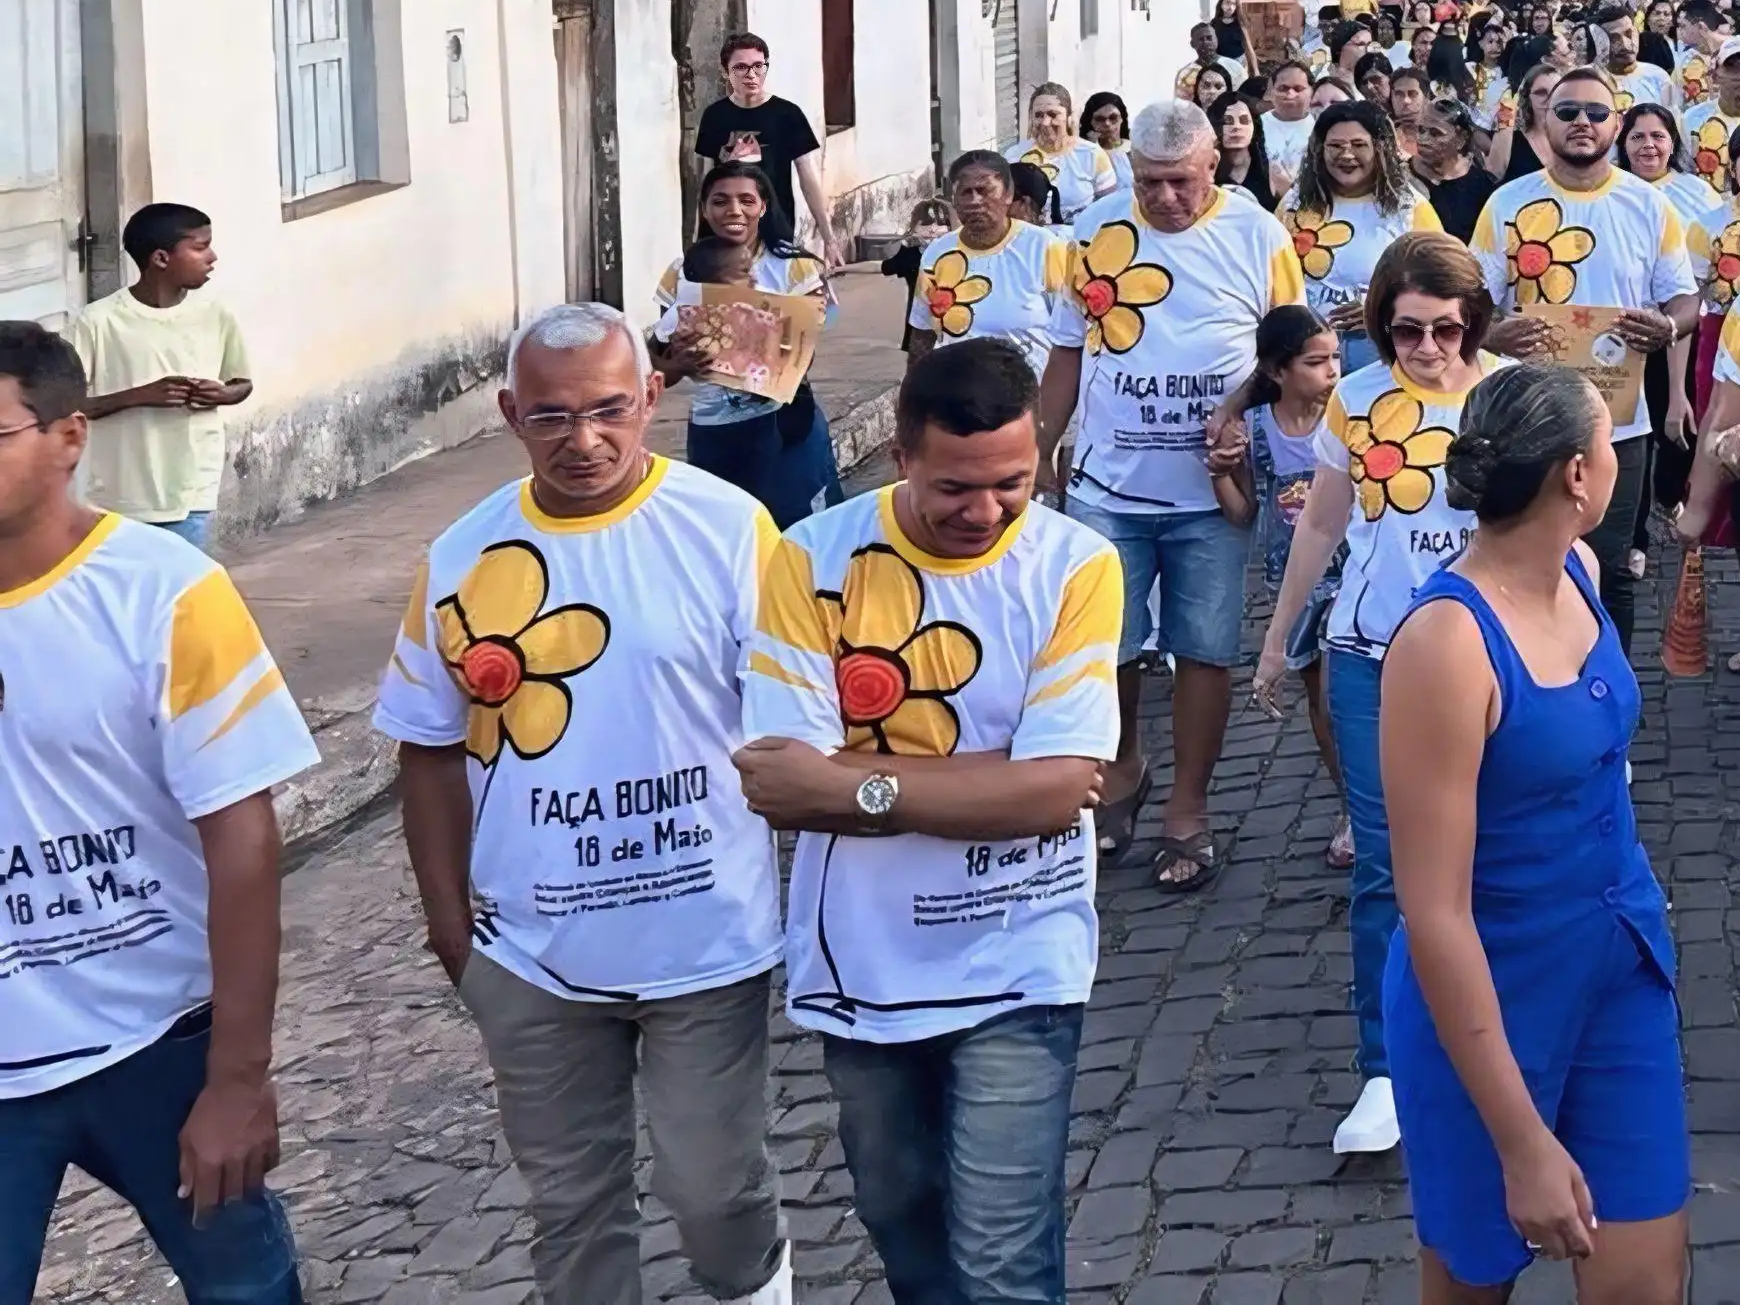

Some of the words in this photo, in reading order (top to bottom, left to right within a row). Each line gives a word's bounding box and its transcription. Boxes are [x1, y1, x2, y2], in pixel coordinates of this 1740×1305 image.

[531, 787, 605, 829] FAÇA
[616, 765, 708, 819] BONITO
[574, 835, 600, 867] 18
[611, 838, 644, 862] de
[654, 818, 713, 856] Maio
[965, 845, 991, 878] 18
[997, 847, 1027, 868] de
[5, 893, 34, 925] 18
[46, 893, 83, 919] de
